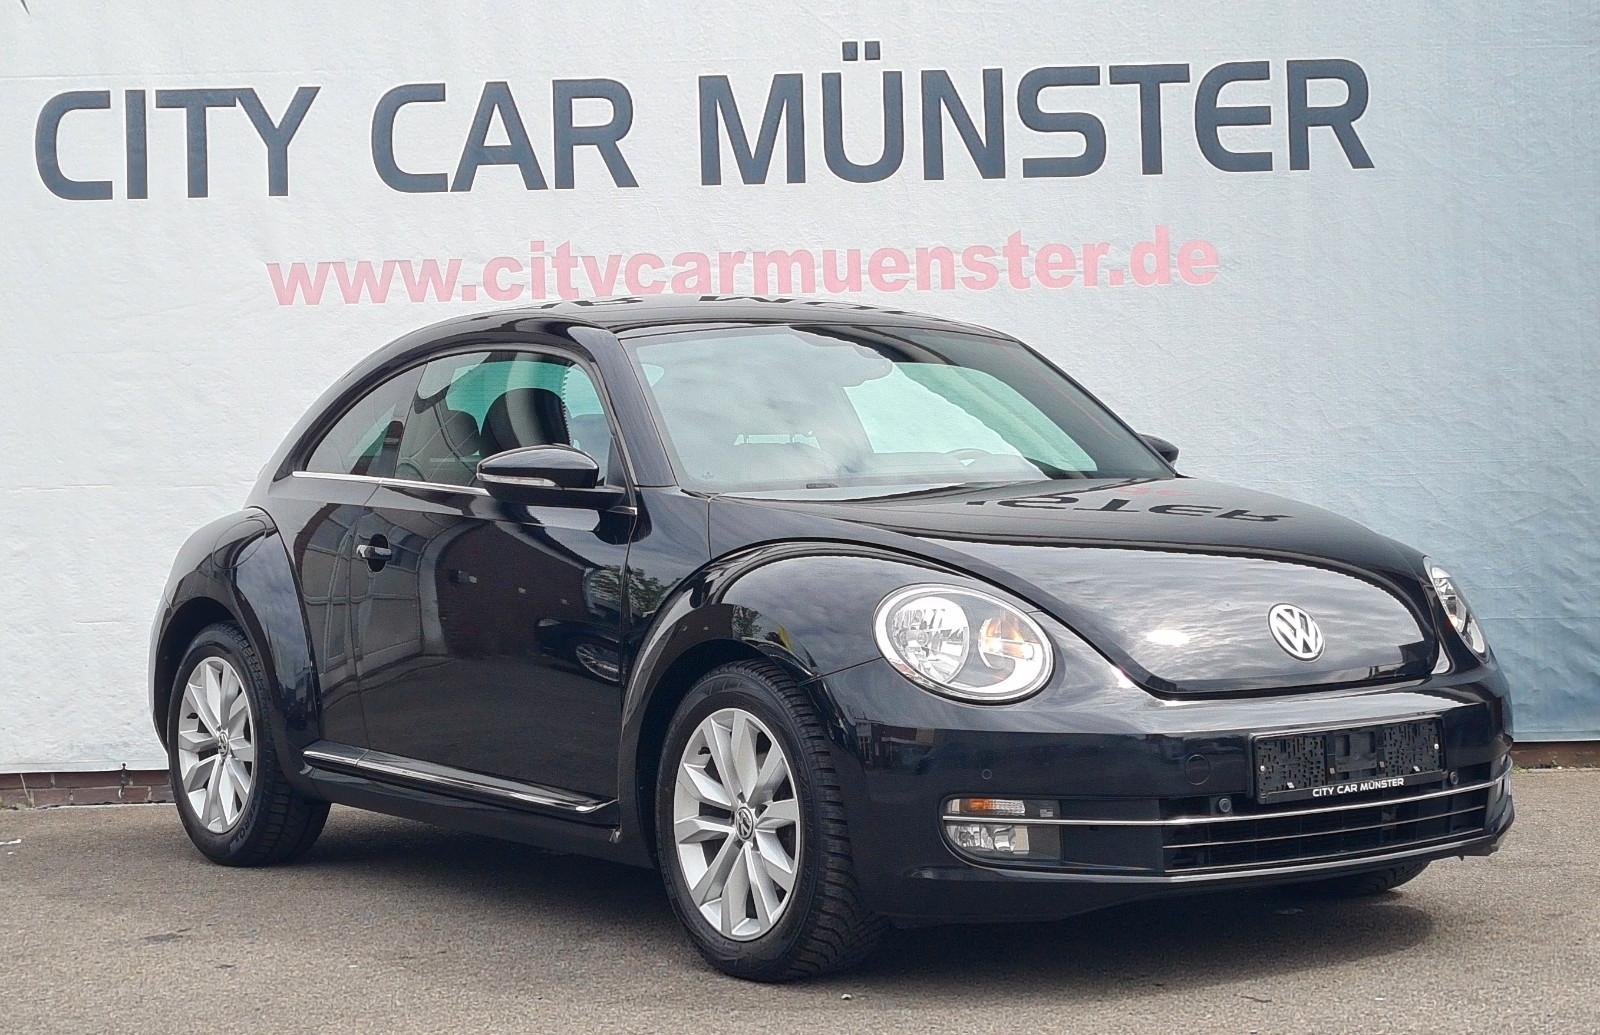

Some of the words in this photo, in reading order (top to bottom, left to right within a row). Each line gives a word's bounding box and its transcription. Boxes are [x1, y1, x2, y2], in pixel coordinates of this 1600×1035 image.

[36, 86, 320, 200] CITY
[372, 79, 639, 193] CAR
[699, 41, 1375, 185] MÜNSTER
[266, 227, 1219, 305] www.citycarmuenster.de
[1312, 787, 1334, 797] CITY
[1337, 783, 1358, 794] CAR
[1360, 777, 1405, 791] MÜNSTER
